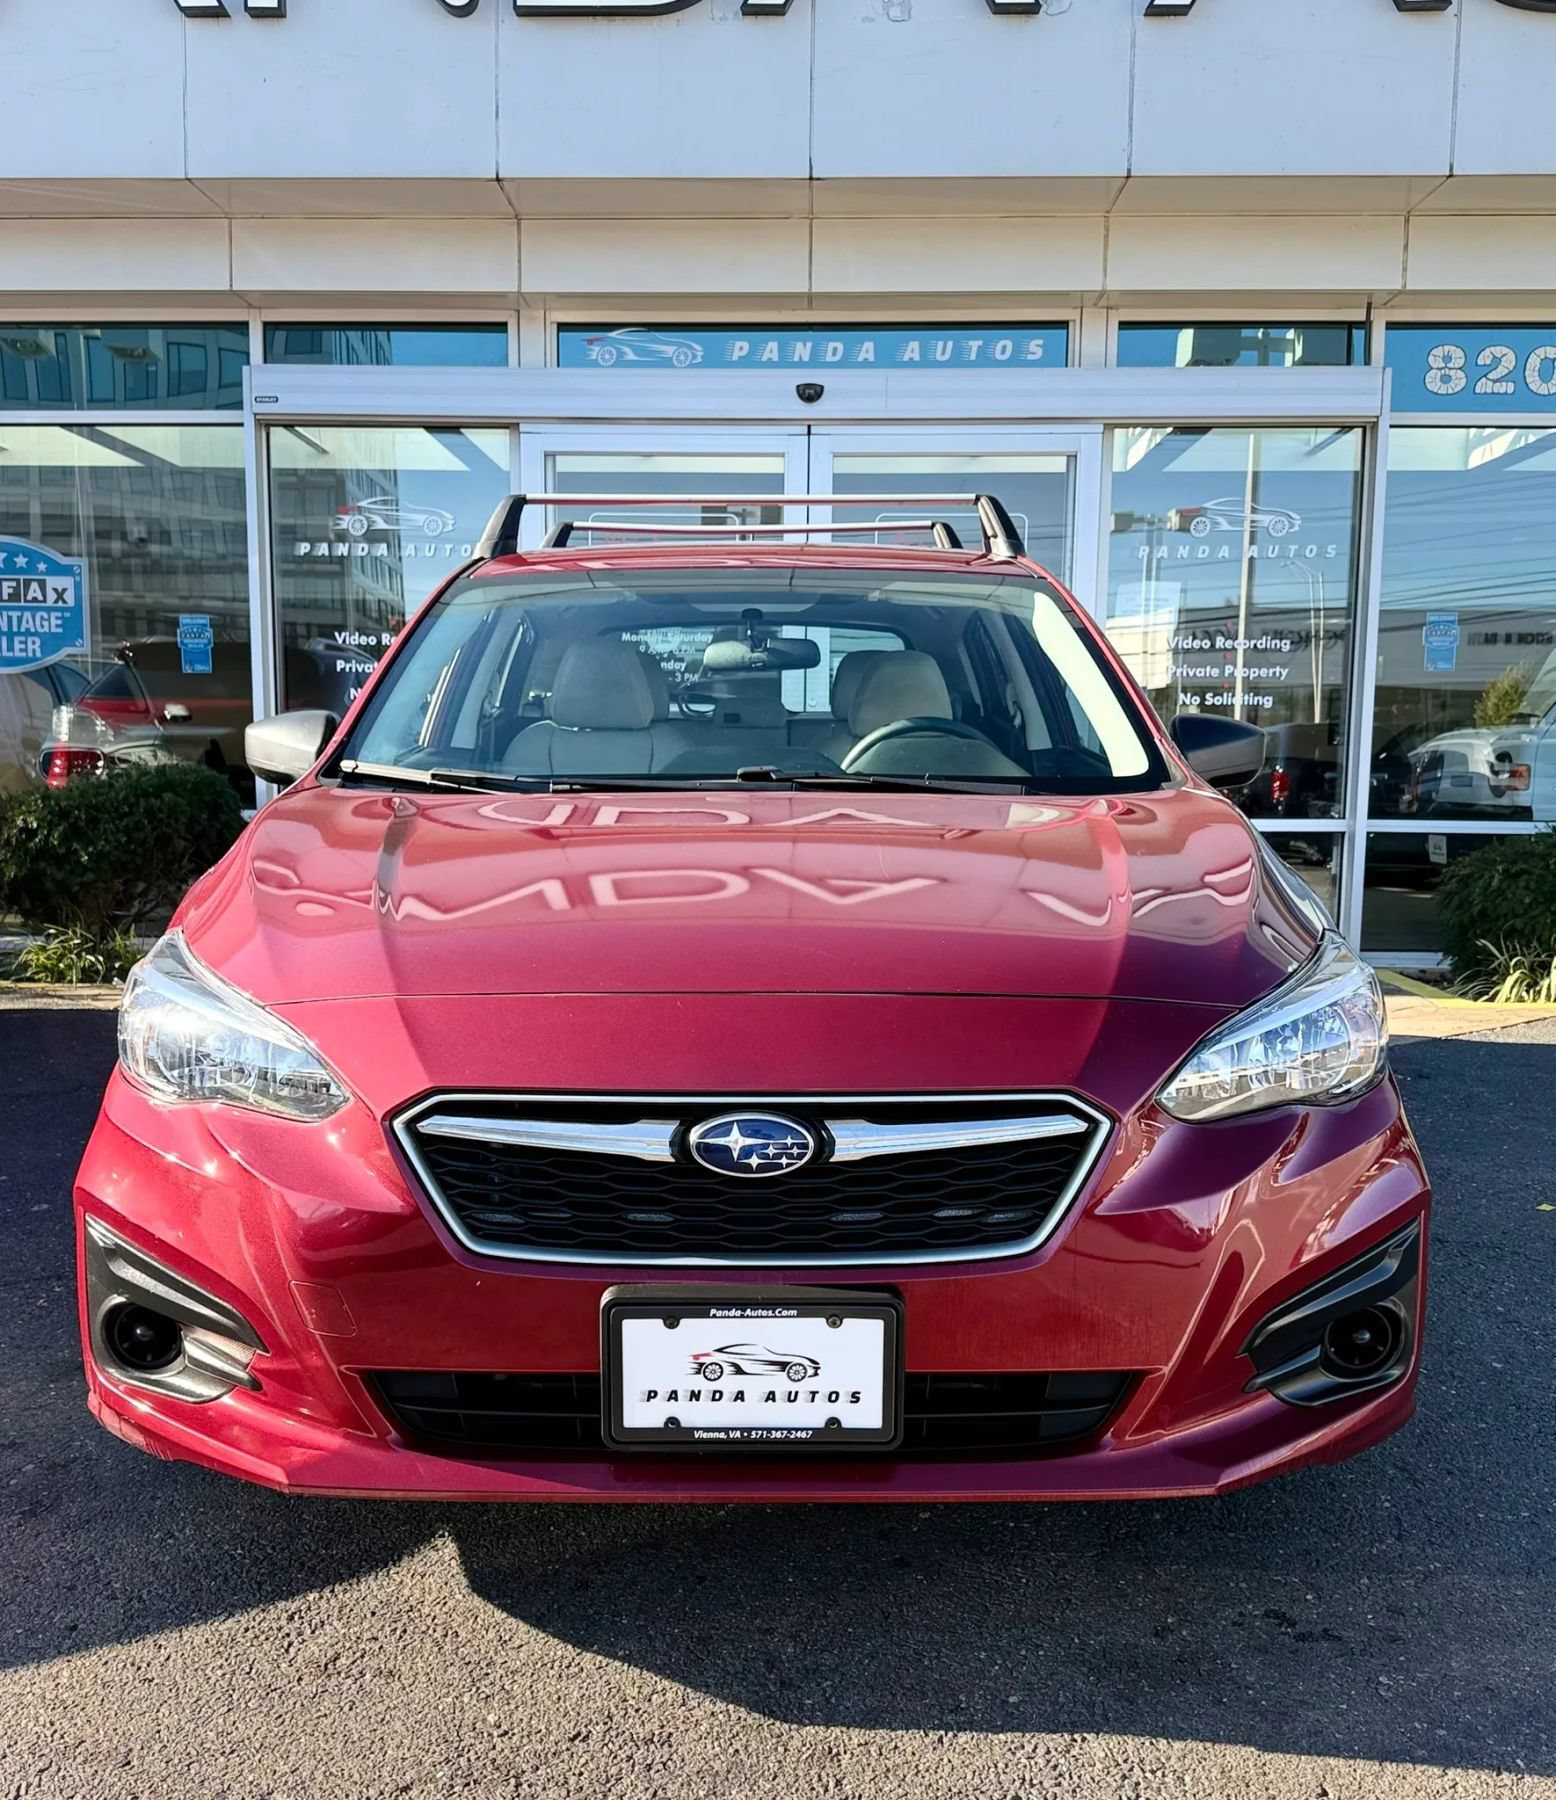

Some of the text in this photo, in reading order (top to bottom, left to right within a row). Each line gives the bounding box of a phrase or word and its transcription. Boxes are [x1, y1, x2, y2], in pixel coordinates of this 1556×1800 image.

[723, 338, 1045, 362] PANDA AUTOS
[295, 542, 389, 557] PANDA
[1138, 544, 1337, 559] PANDA AUTOS
[334, 631, 377, 646] Video
[1167, 635, 1211, 649] Video
[1215, 636, 1291, 651] Recording
[1167, 664, 1289, 680] Private Property
[1178, 692, 1274, 709] No Soliciting
[709, 1308, 798, 1318] Panda-Autos.Com
[643, 1389, 861, 1404] PANDA AUTOS
[693, 1430, 813, 1440] Vienna, VA 571-367-2467
